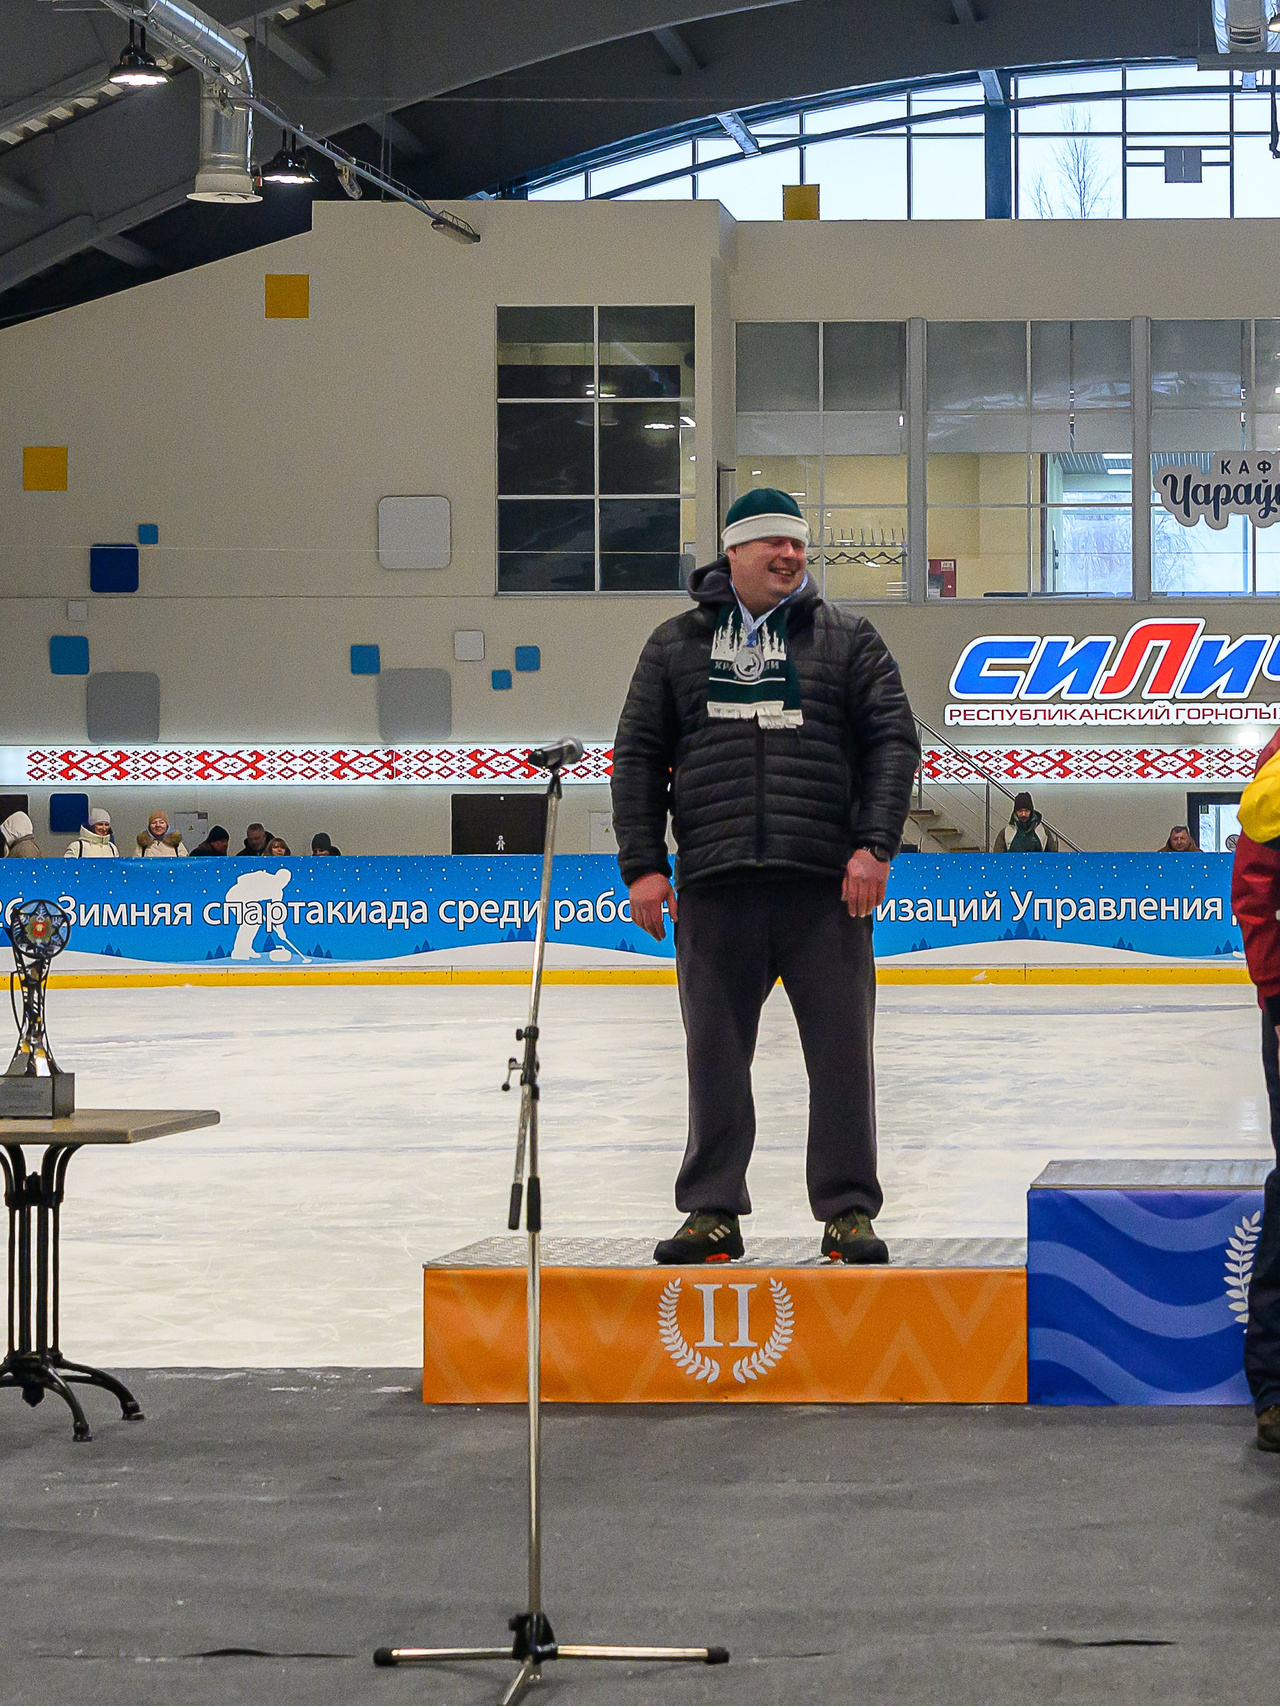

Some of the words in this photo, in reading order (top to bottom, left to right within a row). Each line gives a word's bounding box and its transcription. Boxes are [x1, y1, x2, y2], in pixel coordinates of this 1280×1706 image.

[949, 704, 1170, 721] РЕСПУБЛИКАНСКИЙ
[57, 894, 193, 927] Зимняя
[202, 899, 429, 932] спартакиада
[438, 899, 545, 931] среди
[1009, 890, 1223, 928] Управления
